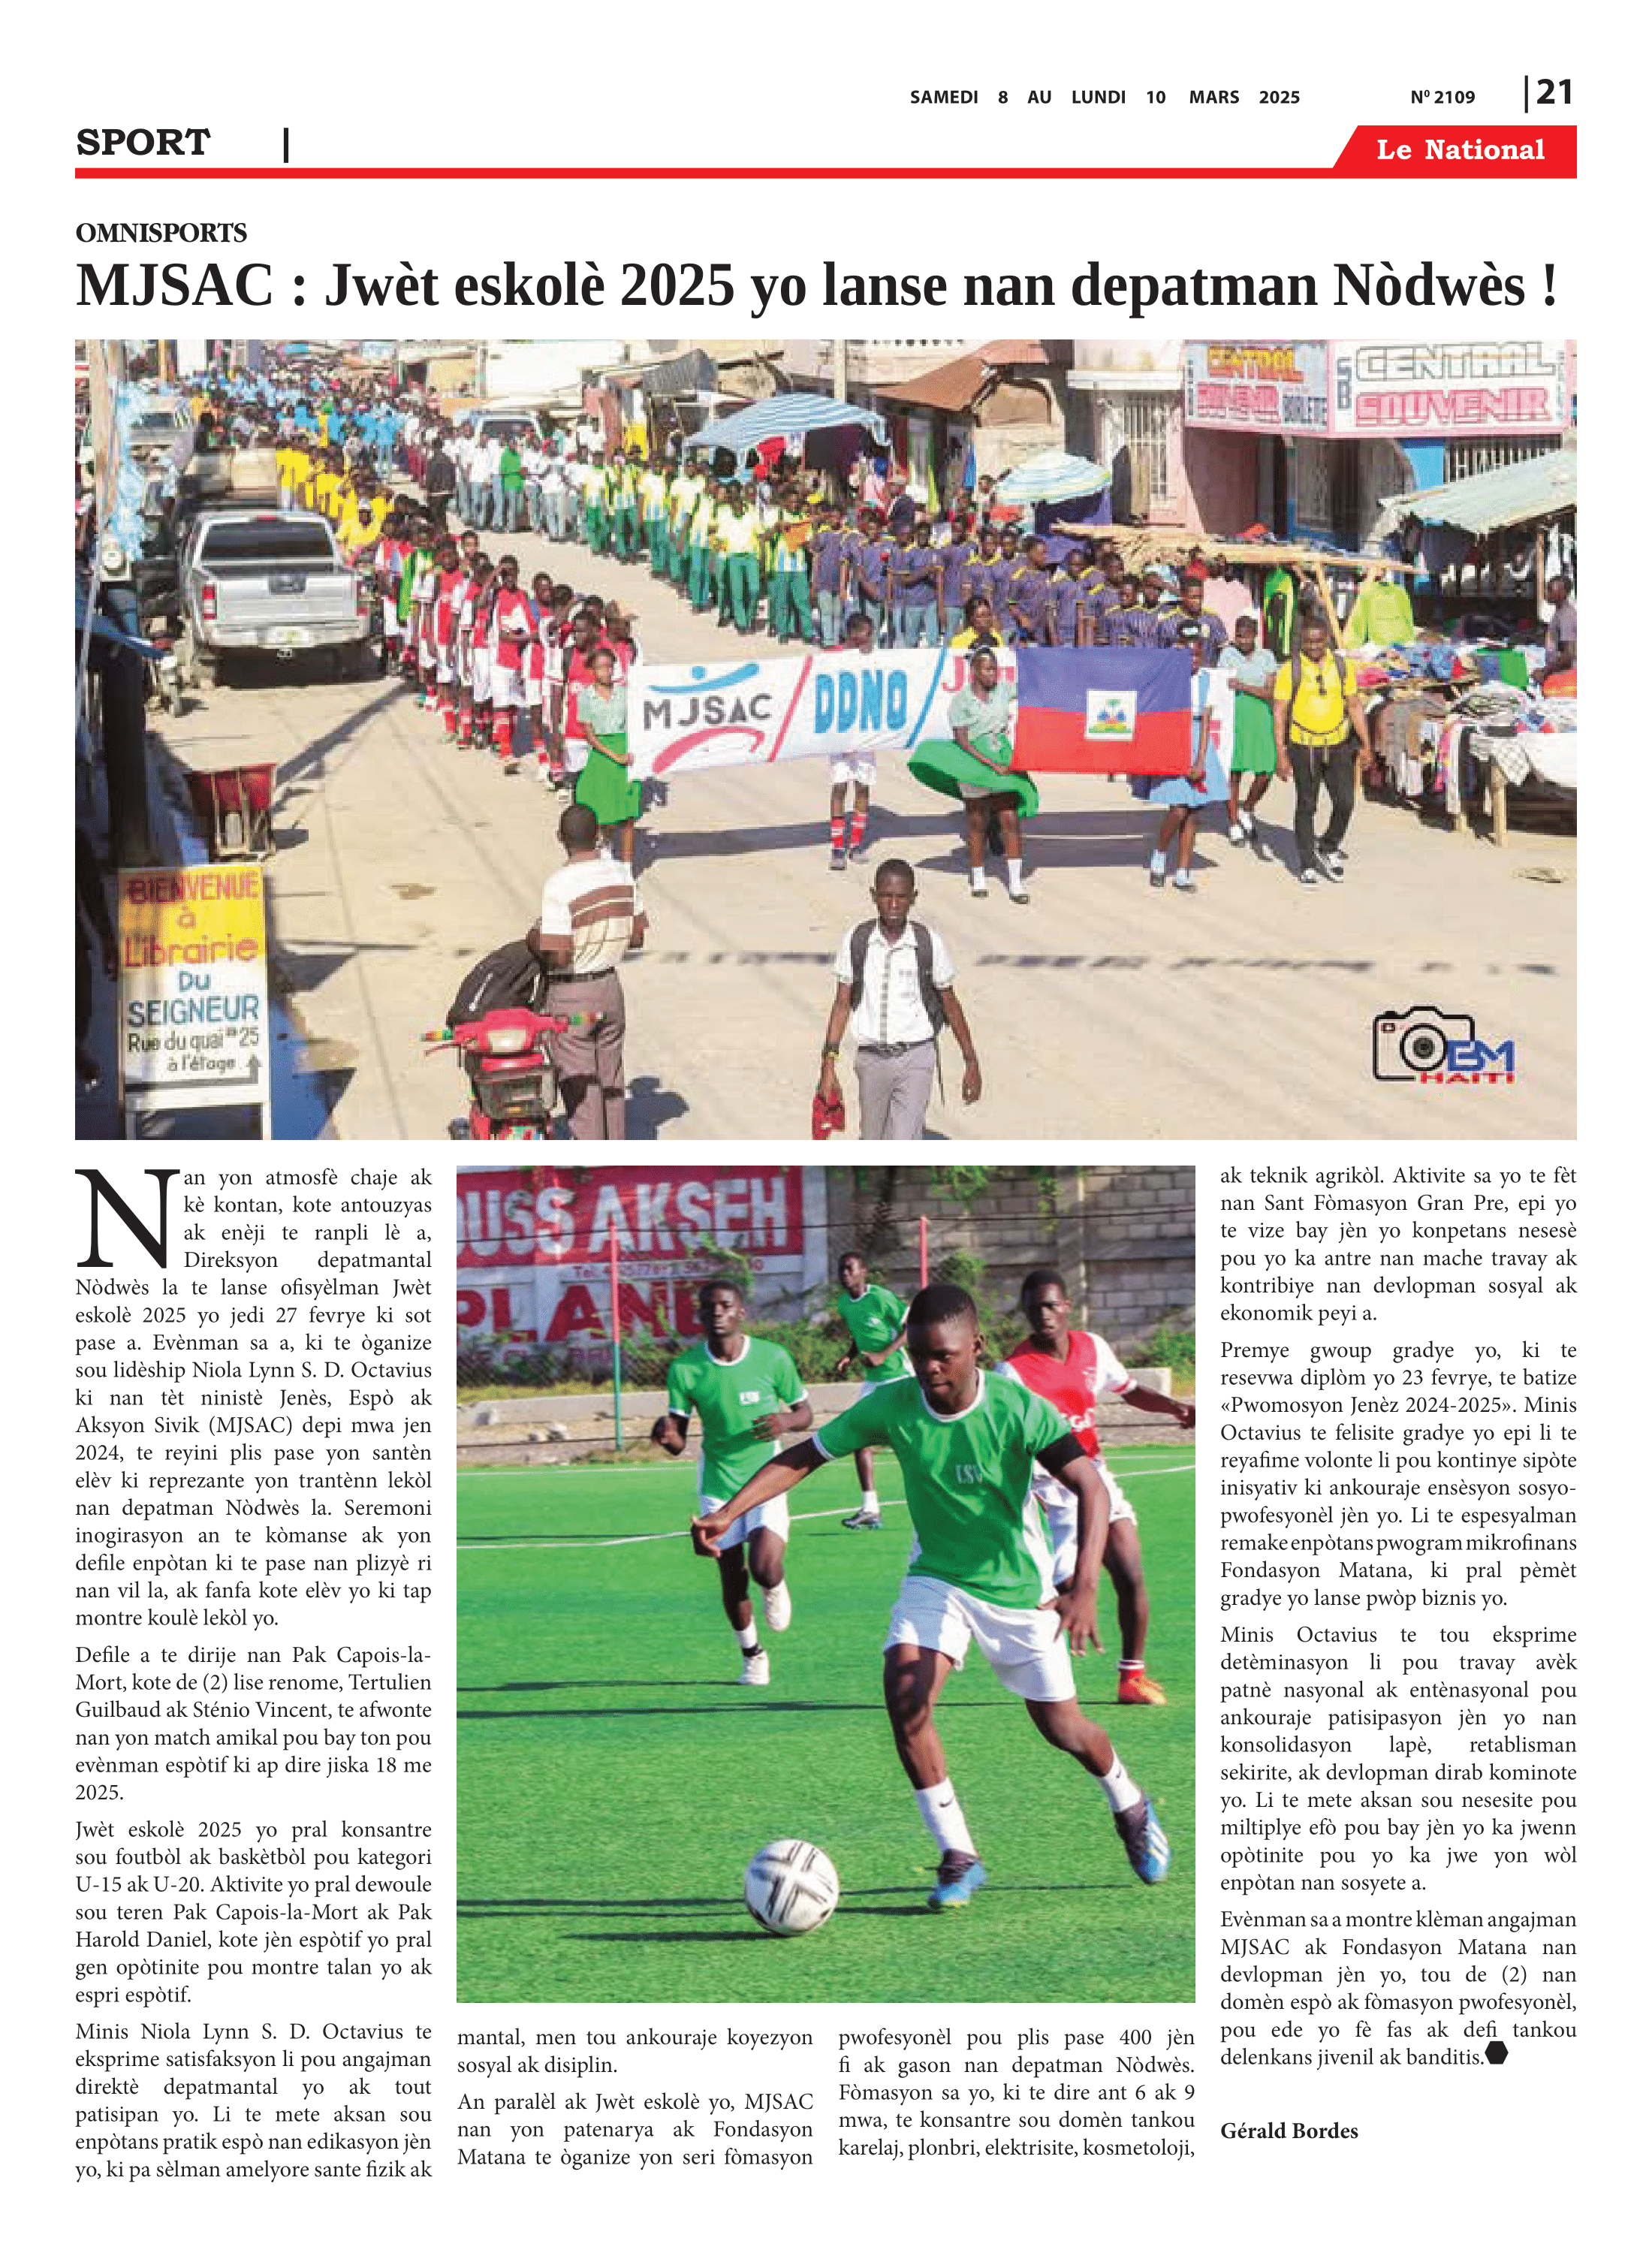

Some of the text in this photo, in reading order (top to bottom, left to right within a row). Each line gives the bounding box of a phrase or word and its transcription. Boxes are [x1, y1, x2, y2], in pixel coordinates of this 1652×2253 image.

[911, 90, 1300, 104] SAMEDI 8 AU LUNDI 10 MARS 2025
[1435, 91, 1475, 104] 2109
[1537, 79, 1570, 104] 21
[77, 128, 211, 155] SPORT
[1378, 138, 1545, 160] Le National
[77, 222, 247, 243] OMNISPORTS
[77, 264, 271, 306] MJSAC
[326, 261, 439, 306] Jwèt
[456, 261, 604, 306] eskolè
[622, 264, 734, 306] 2025
[751, 276, 806, 318] yo
[823, 261, 946, 306] lanse
[964, 276, 1055, 306] nan
[1072, 261, 1318, 318] depatman
[1334, 261, 1524, 306] Nòdwès
[1357, 342, 1555, 381] CENTRAL
[1356, 388, 1552, 427] SOUVENIR
[643, 692, 773, 731] MJSAC
[814, 668, 908, 734] DDNO
[126, 870, 260, 905] BIENVENUE
[125, 933, 260, 967] Librairie
[127, 994, 260, 1028] SEIGNEUR
[128, 1032, 161, 1053] Rue
[164, 1030, 186, 1051] du
[219, 1174, 252, 1190] yon
[267, 1168, 337, 1184] atmosfè
[351, 1168, 397, 1190] chaje
[411, 1168, 433, 1184] ak
[1221, 1166, 1576, 1188] ak teknik agrikòl. Aktivite sa yo te fèt
[457, 1177, 787, 1257] USS AKSEH
[76, 1278, 431, 1300] Nòdwès la te lanse ofisyèlman Jwèt
[76, 1361, 431, 1383] sou lidèship Niola Lynn S. D. Octavius
[1222, 1397, 1576, 1418] «Pwomosyon Jenèz 2024-2025». Minis
[76, 1416, 431, 1438] Aksyon Sivik (MJSAC) depi mwa jen
[1221, 1561, 1576, 1583] Fondasyon Matana, ki pral pèmèt
[76, 1609, 278, 1630] montre koulè lekòl yo.
[76, 1673, 431, 1693] Mort, kote de (2) lise renome, Tertulien
[76, 1700, 431, 1719] Guilbaud ak Sténio Vincent, te afwonte
[1221, 1736, 1576, 1757] konsolidasyon lapè, retablisman
[76, 1875, 431, 1897] U-15 ak U-20. Aktivite yo pral dewoule
[1221, 1938, 1576, 1960] MJSAC ak Fondasyon Matana nan
[458, 2055, 616, 2078] sosyal ak disiplin.
[839, 2055, 1194, 2078] fi ak gason nan depatman Nòdwès.
[1221, 2048, 1484, 2070] delenkans jivenil ak banditis.
[1221, 2122, 1358, 2138] Gérald Bordes
[458, 2148, 812, 2170] Matana te òganize yon seri fòmasyon
[839, 2138, 1194, 2161] karelaj, plonbri, elektrisite, kosmetoloji,
